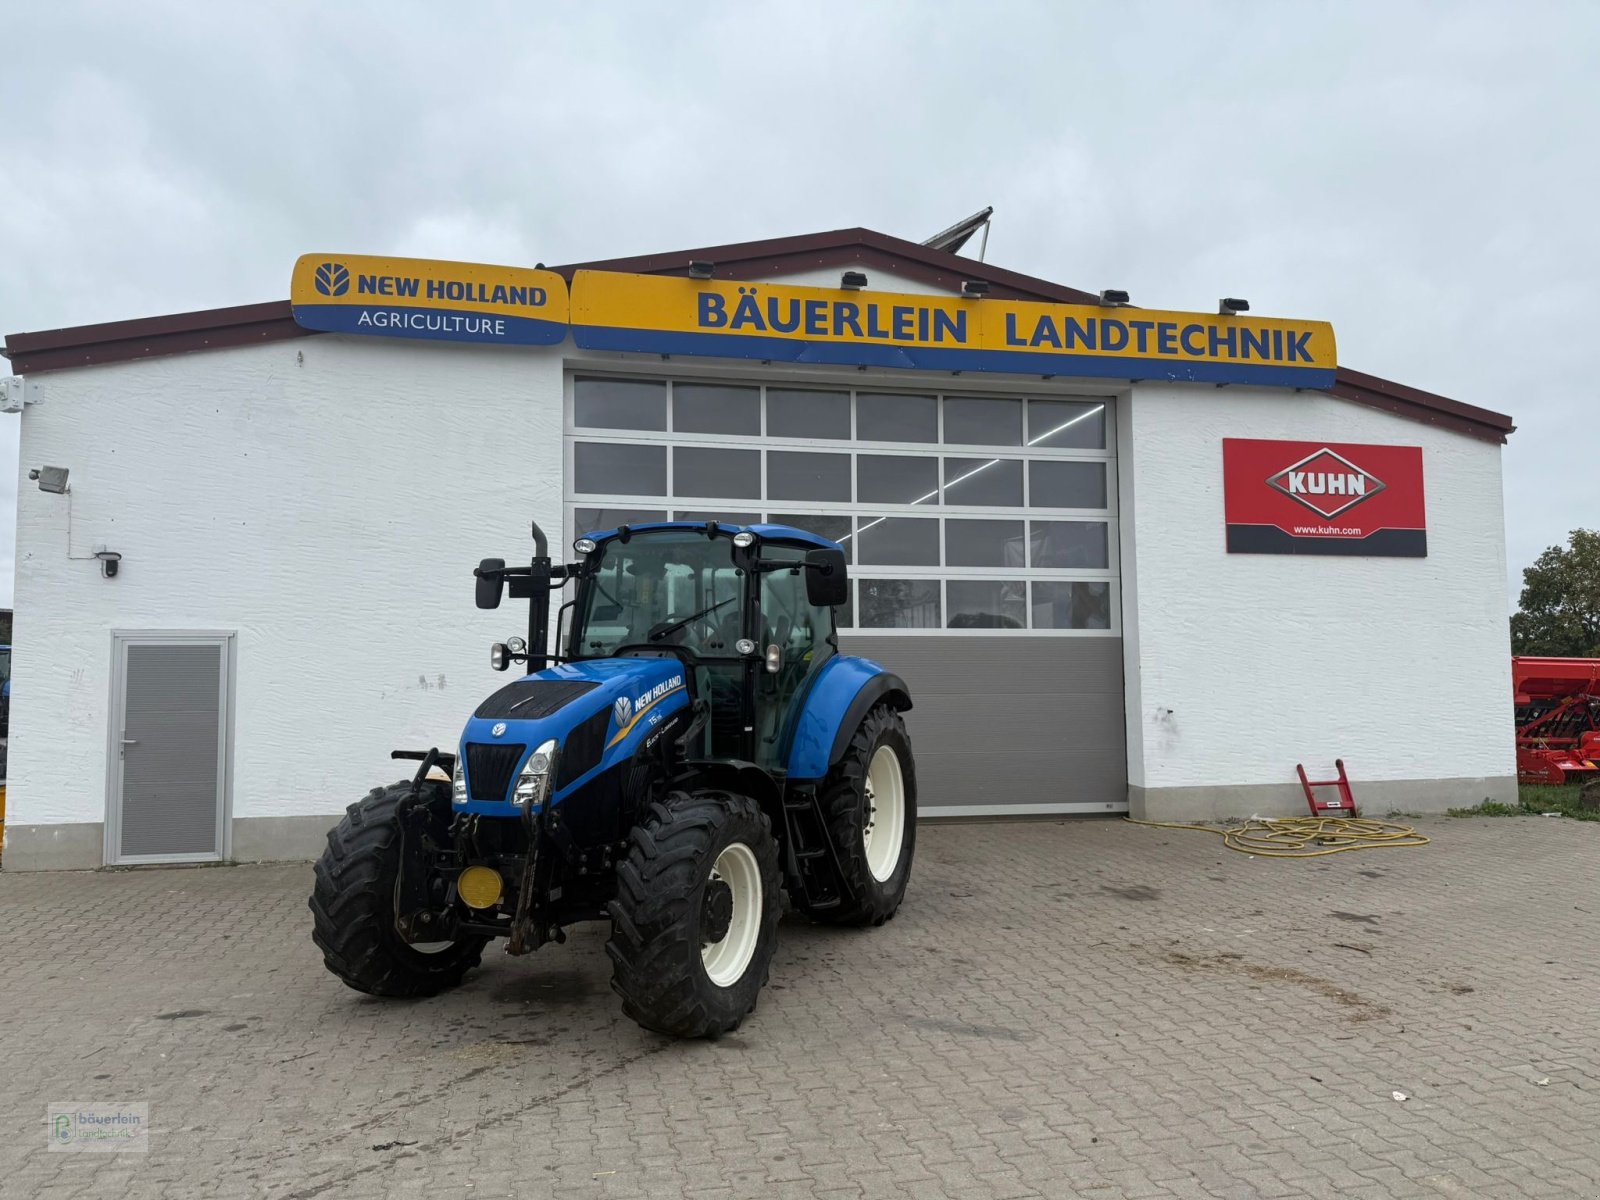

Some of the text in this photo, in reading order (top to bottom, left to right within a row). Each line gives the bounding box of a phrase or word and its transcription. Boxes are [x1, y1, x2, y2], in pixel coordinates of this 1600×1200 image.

[358, 275, 547, 307] NEW HOLLAND
[358, 310, 505, 335] AGRICULTURE
[697, 286, 1314, 362] BÄUERLEIN LANDTECHNIK
[1288, 471, 1365, 496] KUHN
[1293, 525, 1362, 535] www.kuhn.com
[635, 675, 681, 712] NEW HOLLAND
